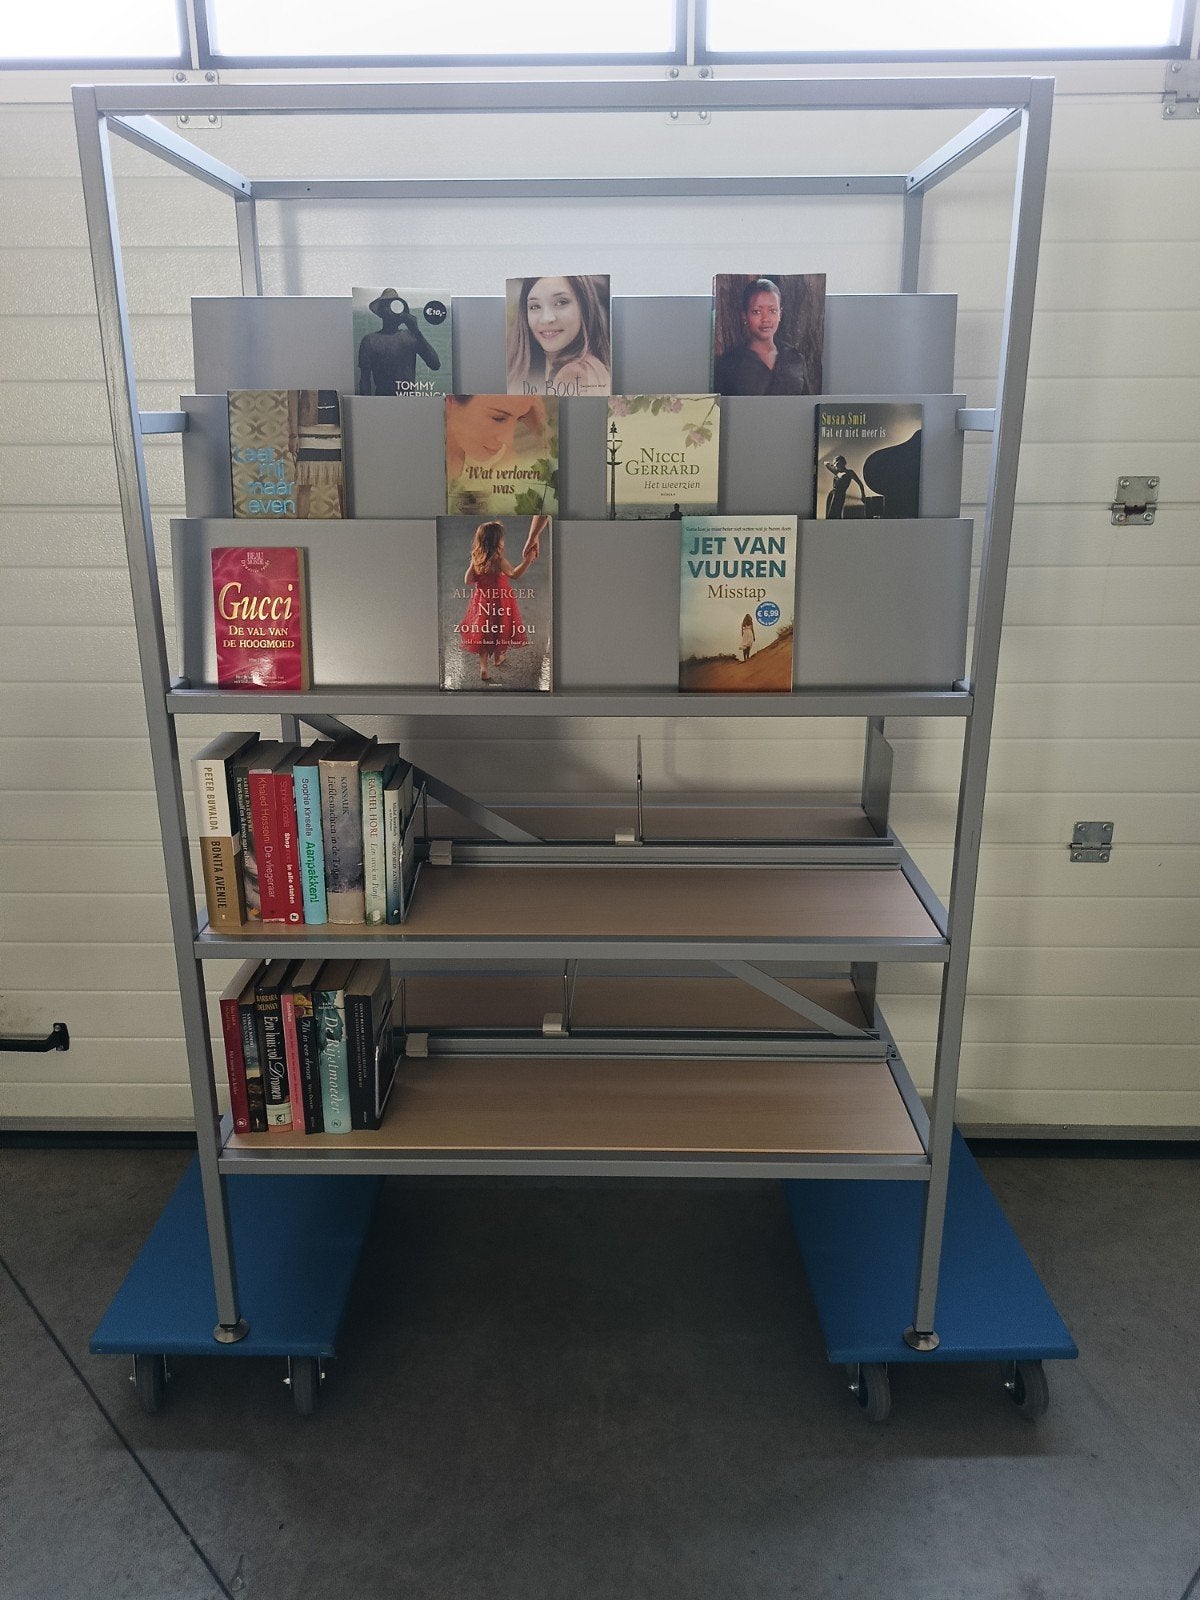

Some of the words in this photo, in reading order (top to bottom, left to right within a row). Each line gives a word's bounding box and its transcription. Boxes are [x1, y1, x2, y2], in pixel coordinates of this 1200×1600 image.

[395, 380, 435, 391] TOMMY
[522, 380, 538, 396] De
[821, 412, 846, 425] Susan
[847, 411, 867, 425] Smit
[821, 427, 833, 438] Wat
[835, 429, 843, 438] er
[845, 427, 859, 438] niet
[861, 429, 877, 438] meer
[879, 426, 886, 438] is
[465, 465, 493, 479] Wat
[496, 464, 541, 480] verloren
[625, 459, 700, 475] GERRARD
[492, 484, 515, 494] was
[644, 480, 660, 489] Het
[661, 480, 701, 489] weerzien
[248, 498, 296, 514] even
[689, 536, 727, 555] JET
[733, 536, 786, 555] VAN
[687, 560, 786, 579] VUUREN
[218, 581, 293, 621] Gucci
[453, 588, 475, 599] ALI
[478, 588, 536, 599] MERCER
[708, 584, 767, 602] Misstap
[477, 602, 512, 616] Niet
[453, 620, 506, 633] zonder
[511, 620, 536, 637] jou
[223, 640, 236, 648] DE
[239, 640, 295, 648] HOOGMOED
[203, 767, 215, 791] PETER
[258, 777, 269, 806] Khaled
[301, 778, 311, 805] Sophie
[340, 776, 350, 815] KONSALIK
[368, 778, 377, 811] RACHEL
[207, 794, 219, 831] BUWALDA
[327, 775, 338, 834] Liefdesnachten
[261, 809, 271, 844] Hosseini
[304, 807, 313, 837] Kinsella
[369, 814, 378, 838] HORE
[331, 836, 339, 844] in
[211, 841, 224, 873] BONITA
[264, 846, 273, 858] De
[332, 846, 340, 856] de
[264, 860, 275, 898] vliegeraar
[305, 841, 319, 903] Aanpakken!
[214, 876, 227, 909] AVENUE
[263, 1016, 278, 1031] Een
[324, 1016, 338, 1034] De
[265, 1032, 280, 1048] huis
[267, 1049, 283, 1060] vol
[323, 1037, 344, 1114] Rijstmoeder
